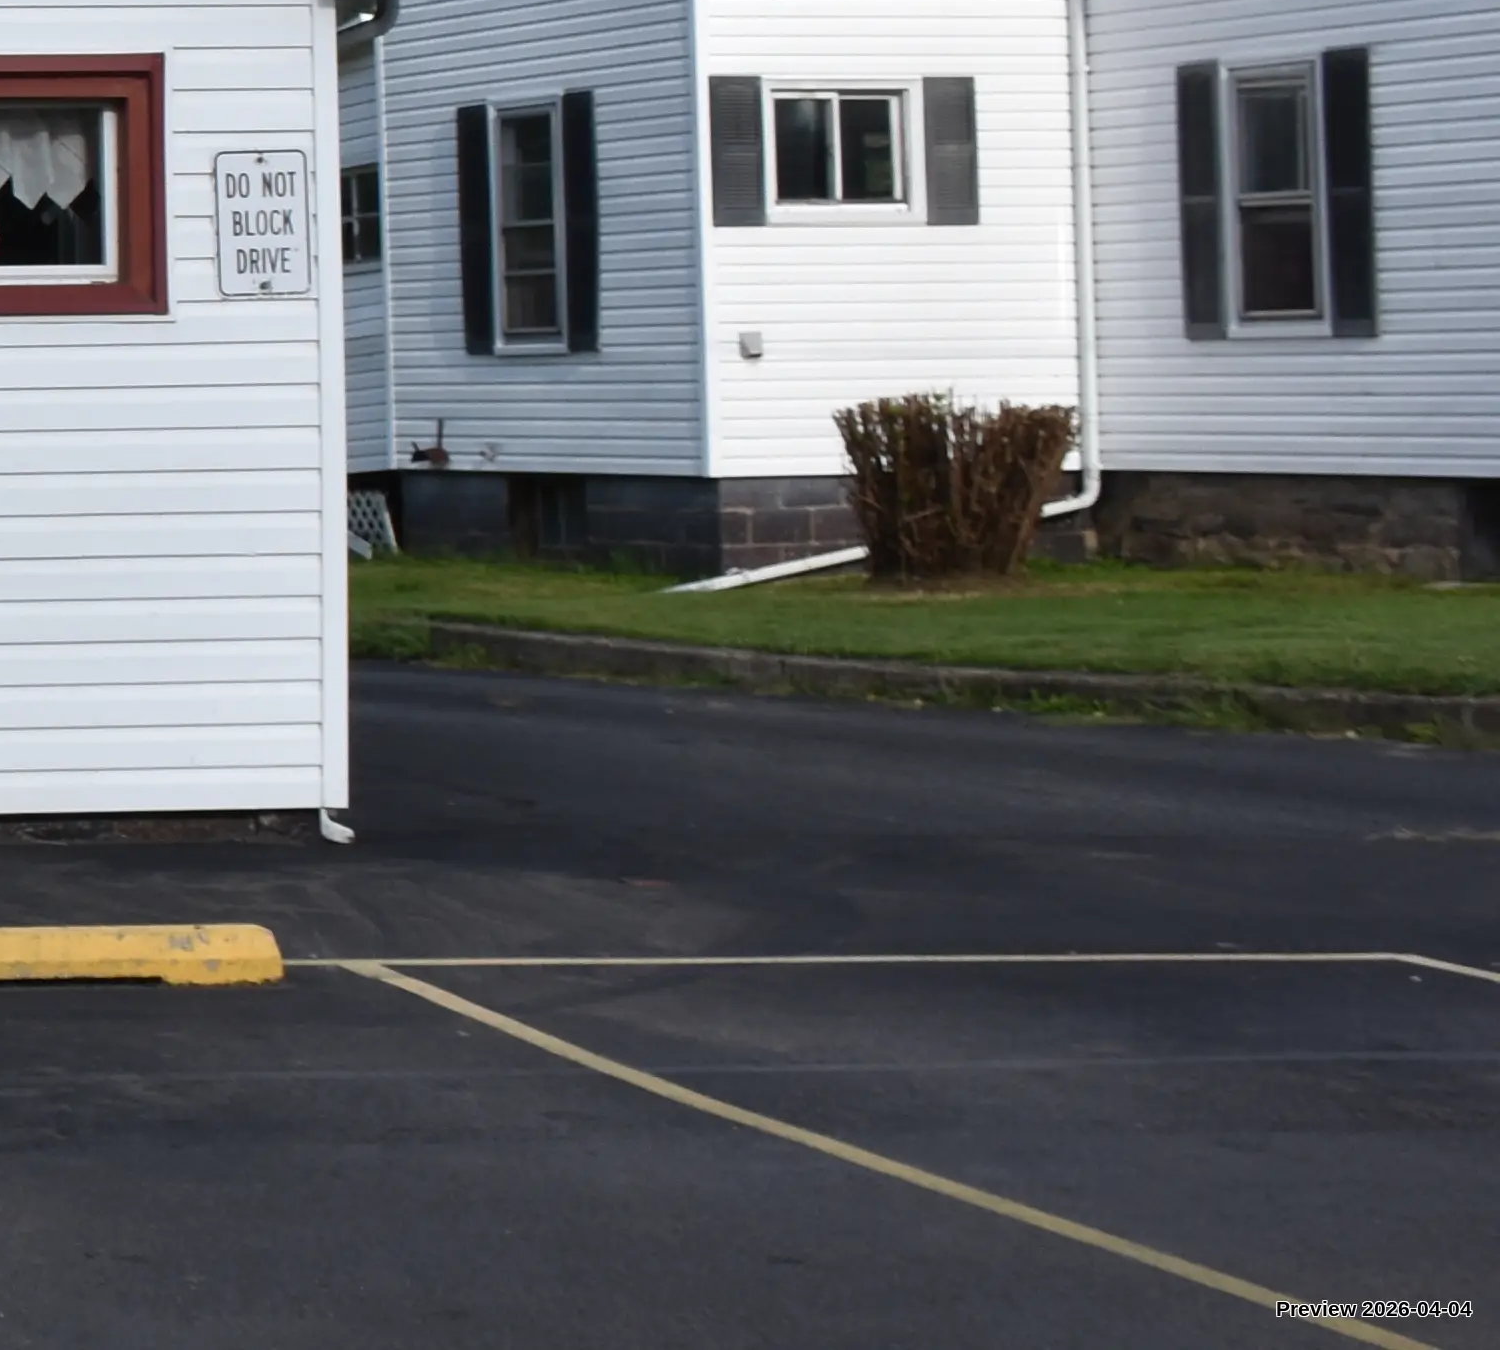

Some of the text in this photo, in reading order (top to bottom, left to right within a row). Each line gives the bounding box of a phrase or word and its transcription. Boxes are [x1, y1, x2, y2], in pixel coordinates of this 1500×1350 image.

[225, 171, 297, 199] DO NOT
[232, 209, 294, 236] BLOCK
[236, 248, 291, 274] DRIVE
